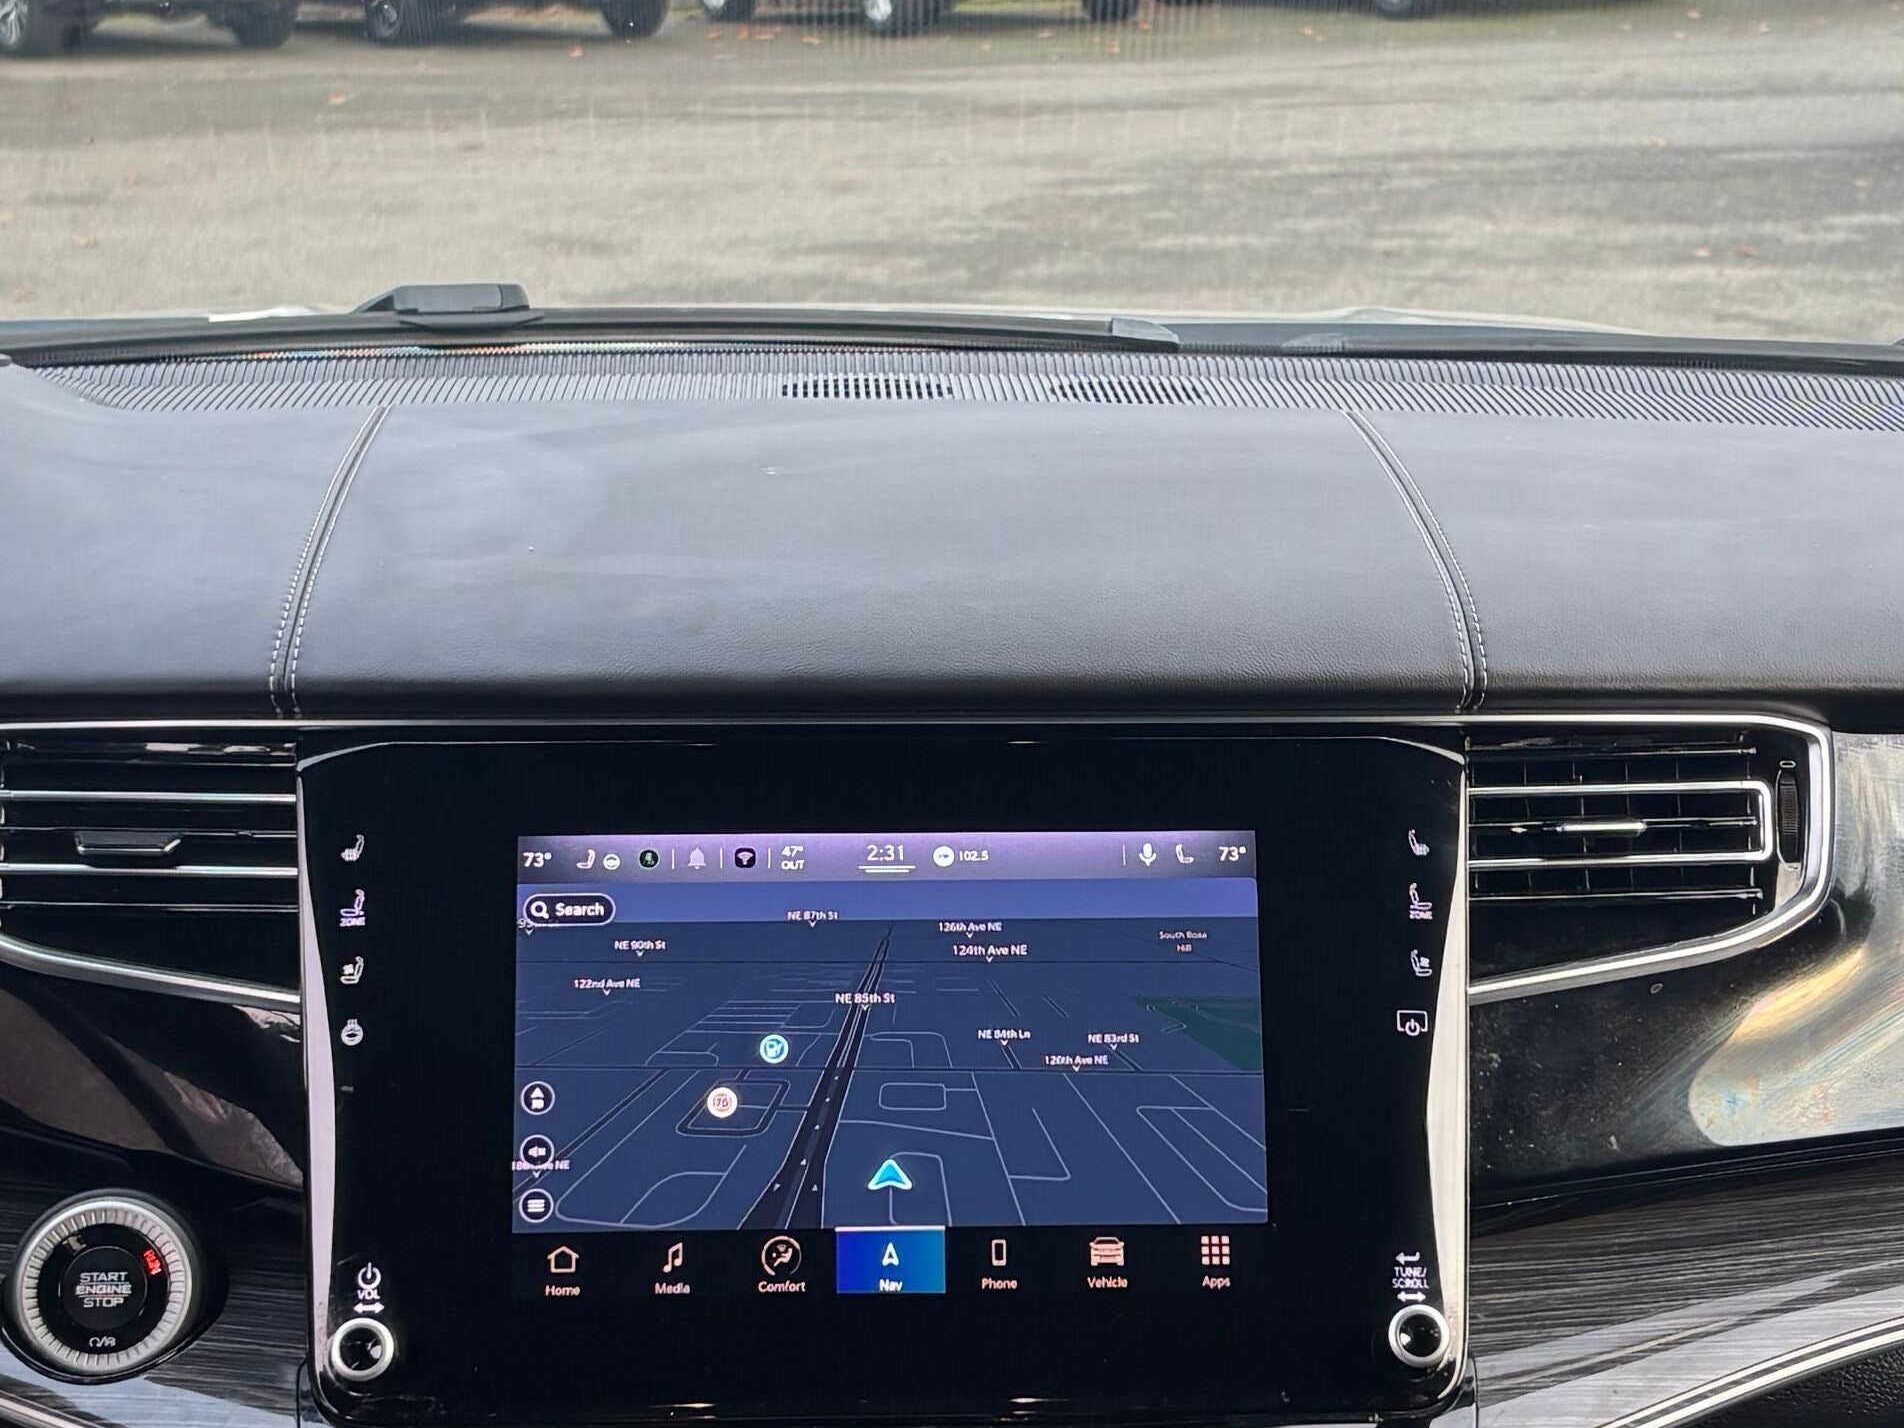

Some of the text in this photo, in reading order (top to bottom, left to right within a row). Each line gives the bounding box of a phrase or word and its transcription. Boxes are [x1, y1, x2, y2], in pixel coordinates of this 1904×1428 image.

[866, 844, 905, 862] 2:31
[959, 849, 990, 862] 102.5
[1218, 845, 1247, 863] 73°
[522, 851, 553, 869] 73°
[781, 859, 805, 871] OUT
[554, 902, 605, 918] Search
[1010, 944, 1027, 956] NE
[835, 993, 895, 1004] NE 85th St
[79, 1271, 129, 1283] START
[981, 1277, 1018, 1290] Phone
[1087, 1276, 1128, 1289] Vehicle
[1202, 1275, 1231, 1290] Apps
[74, 1283, 133, 1295] ENGINE
[545, 1284, 581, 1297] Home
[654, 1282, 691, 1295] Media
[758, 1280, 806, 1293] Comfort
[879, 1279, 903, 1292] Nav
[1391, 1278, 1431, 1290] SCROLL
[82, 1297, 125, 1308] STOP
